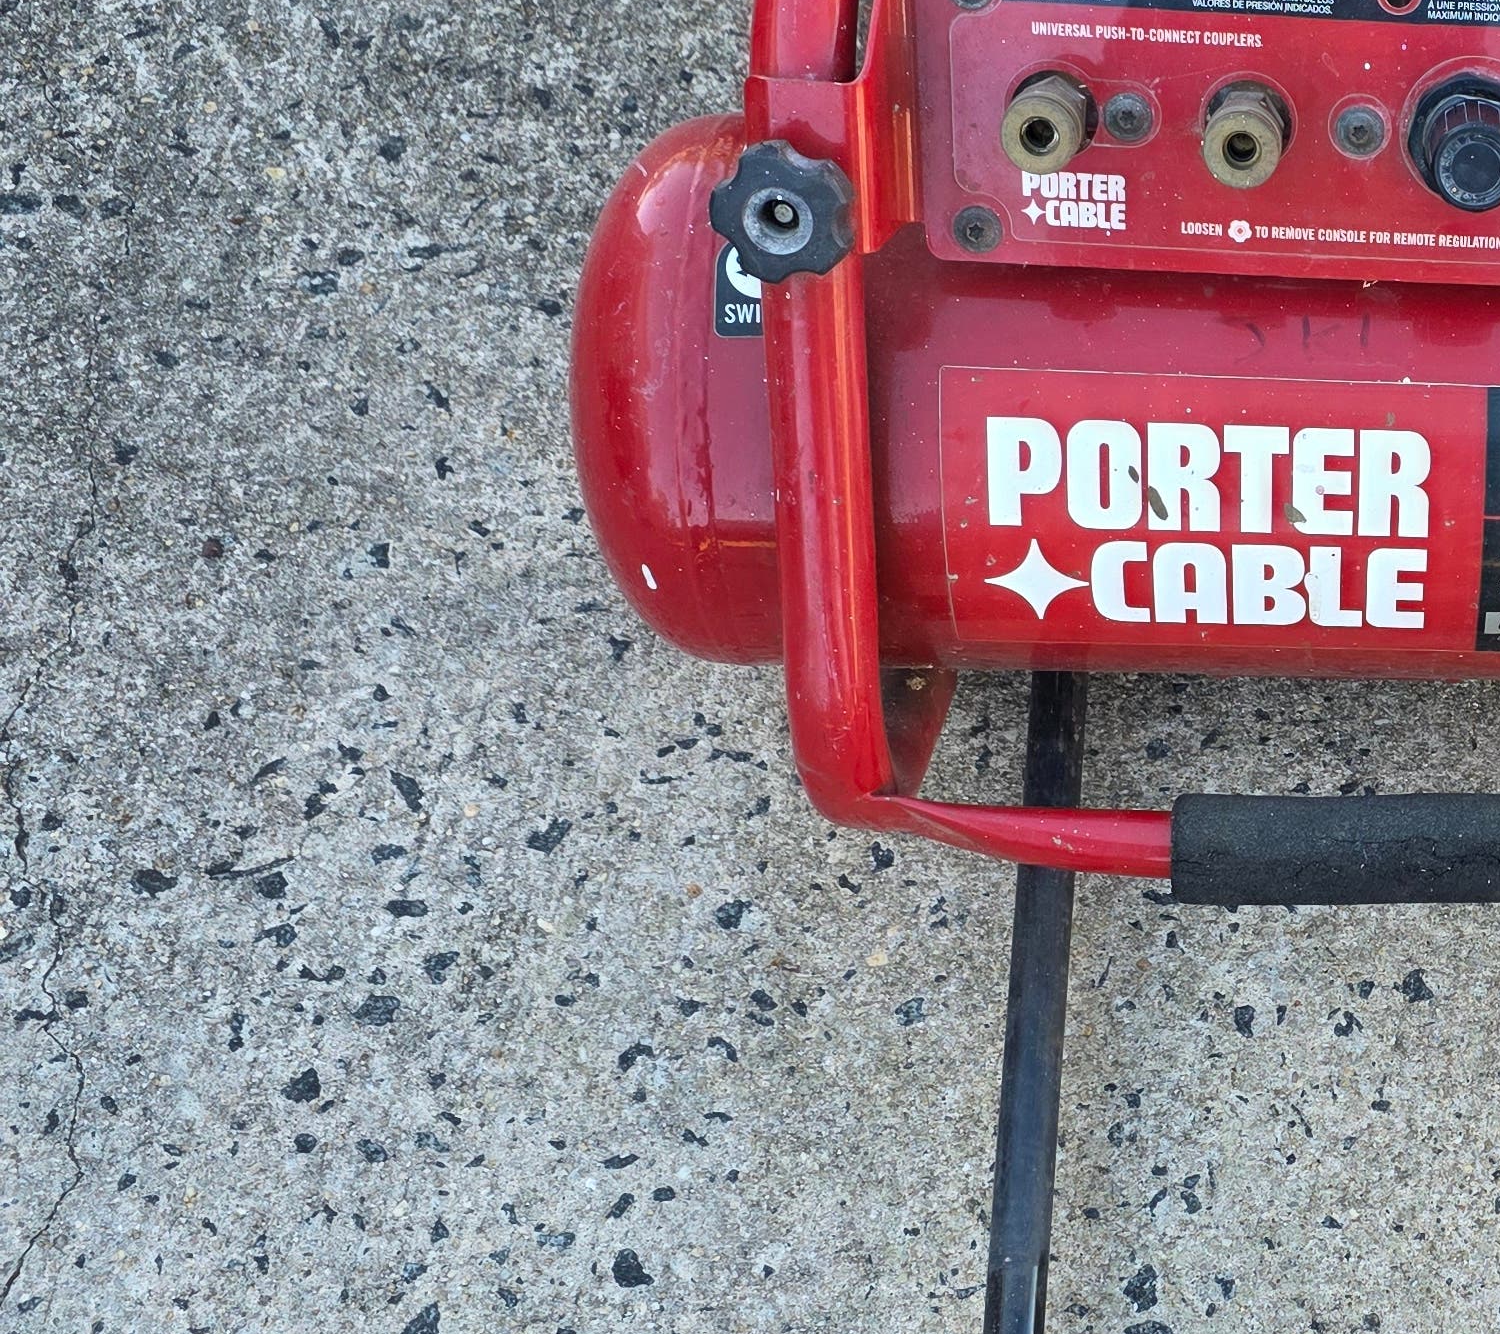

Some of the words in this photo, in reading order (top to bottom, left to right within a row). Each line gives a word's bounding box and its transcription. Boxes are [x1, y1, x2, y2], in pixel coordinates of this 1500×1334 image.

[1233, 0, 1244, 8] DE
[1284, 4, 1332, 14] INDICADOS.
[1428, 11, 1472, 20] MAXIMUM
[1437, 1, 1455, 10] UNE
[1032, 21, 1092, 38] UNIVERSAL
[1096, 25, 1200, 44] PUSH-TO-CONNECT
[1022, 170, 1126, 202] PORTER
[1045, 200, 1126, 230] CABLE
[1180, 221, 1222, 236] LOOSEN
[1255, 225, 1268, 238] TO
[1272, 226, 1315, 241] REMOVE
[1318, 229, 1366, 244] CONSOLE
[1370, 231, 1390, 244] FOR
[1394, 232, 1436, 247] REMOTE
[724, 304, 760, 324] SWI
[986, 416, 1432, 538] PORTER
[1090, 539, 1428, 629] CABLE
